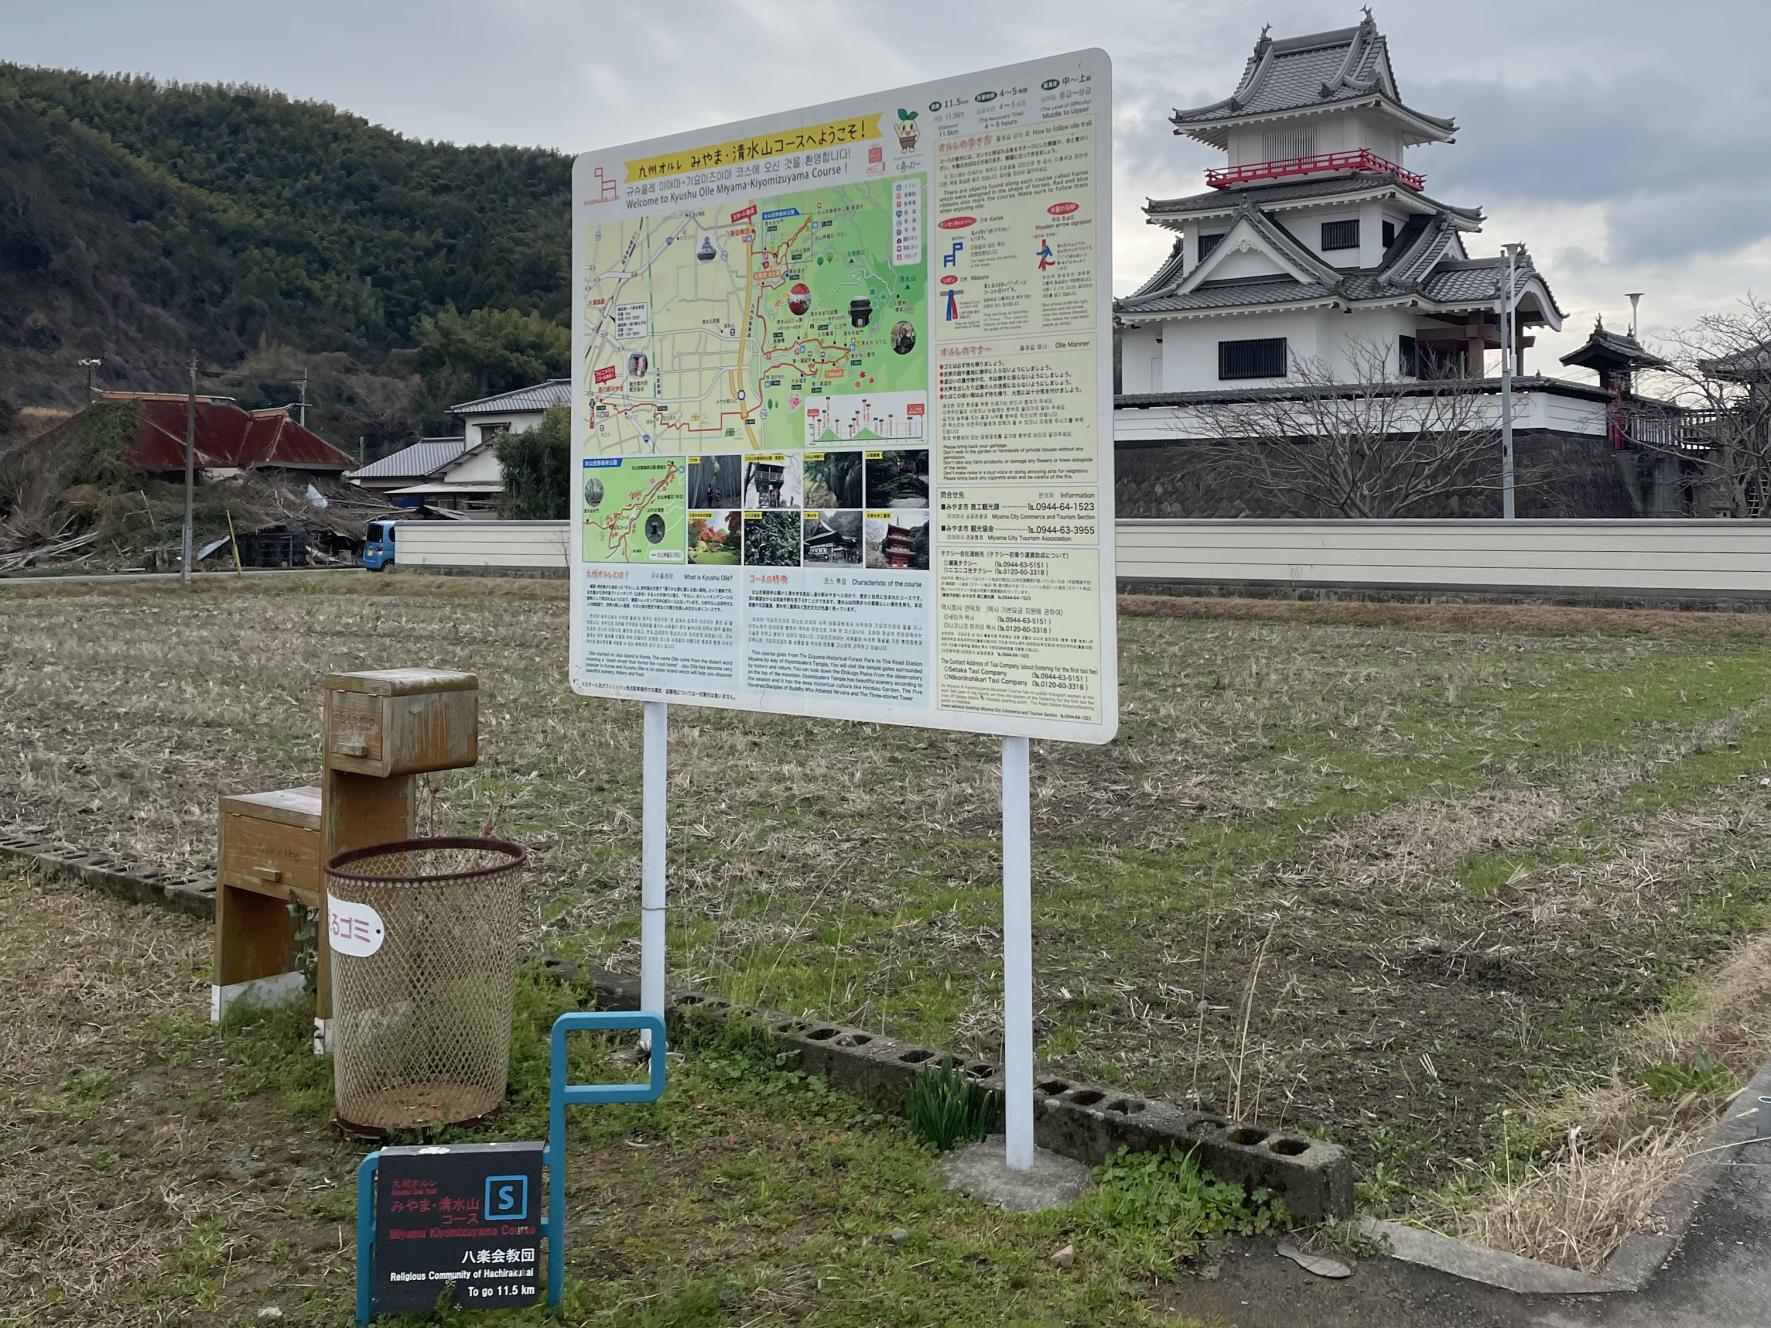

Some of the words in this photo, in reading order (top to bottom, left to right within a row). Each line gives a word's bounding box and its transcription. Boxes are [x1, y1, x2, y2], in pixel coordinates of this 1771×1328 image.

[1042, 110, 1062, 119] Middle
[1071, 105, 1090, 116] Upper
[1000, 117, 1017, 126] hours
[638, 158, 682, 178] 九州オルレ
[764, 160, 779, 174] 오신
[785, 156, 800, 170] 것을
[626, 194, 658, 209] Welcome
[660, 194, 668, 203] to
[670, 188, 696, 203] Kyushu
[698, 185, 714, 197] Olle
[811, 163, 841, 178] Course
[1068, 340, 1089, 348] Manner
[684, 573, 696, 581] What
[696, 574, 700, 582] is
[702, 574, 719, 582] Kyushu
[720, 574, 732, 583] Olle?
[851, 578, 886, 587] Characteristic
[887, 579, 893, 588] of
[894, 579, 903, 588] the
[904, 579, 922, 589] course
[981, 669, 1006, 677] Company
[1001, 678, 1027, 687] Company
[328, 913, 370, 943] るゴミ
[498, 1185, 514, 1210] S
[442, 1213, 479, 1224] コース
[461, 1248, 535, 1264] 八楽会教団
[390, 1272, 426, 1282] Religious
[428, 1269, 471, 1282] Community
[473, 1269, 482, 1279] of
[468, 1287, 479, 1297] To
[481, 1287, 493, 1298] go
[497, 1285, 518, 1296] 11.5
[521, 1284, 535, 1295] km
